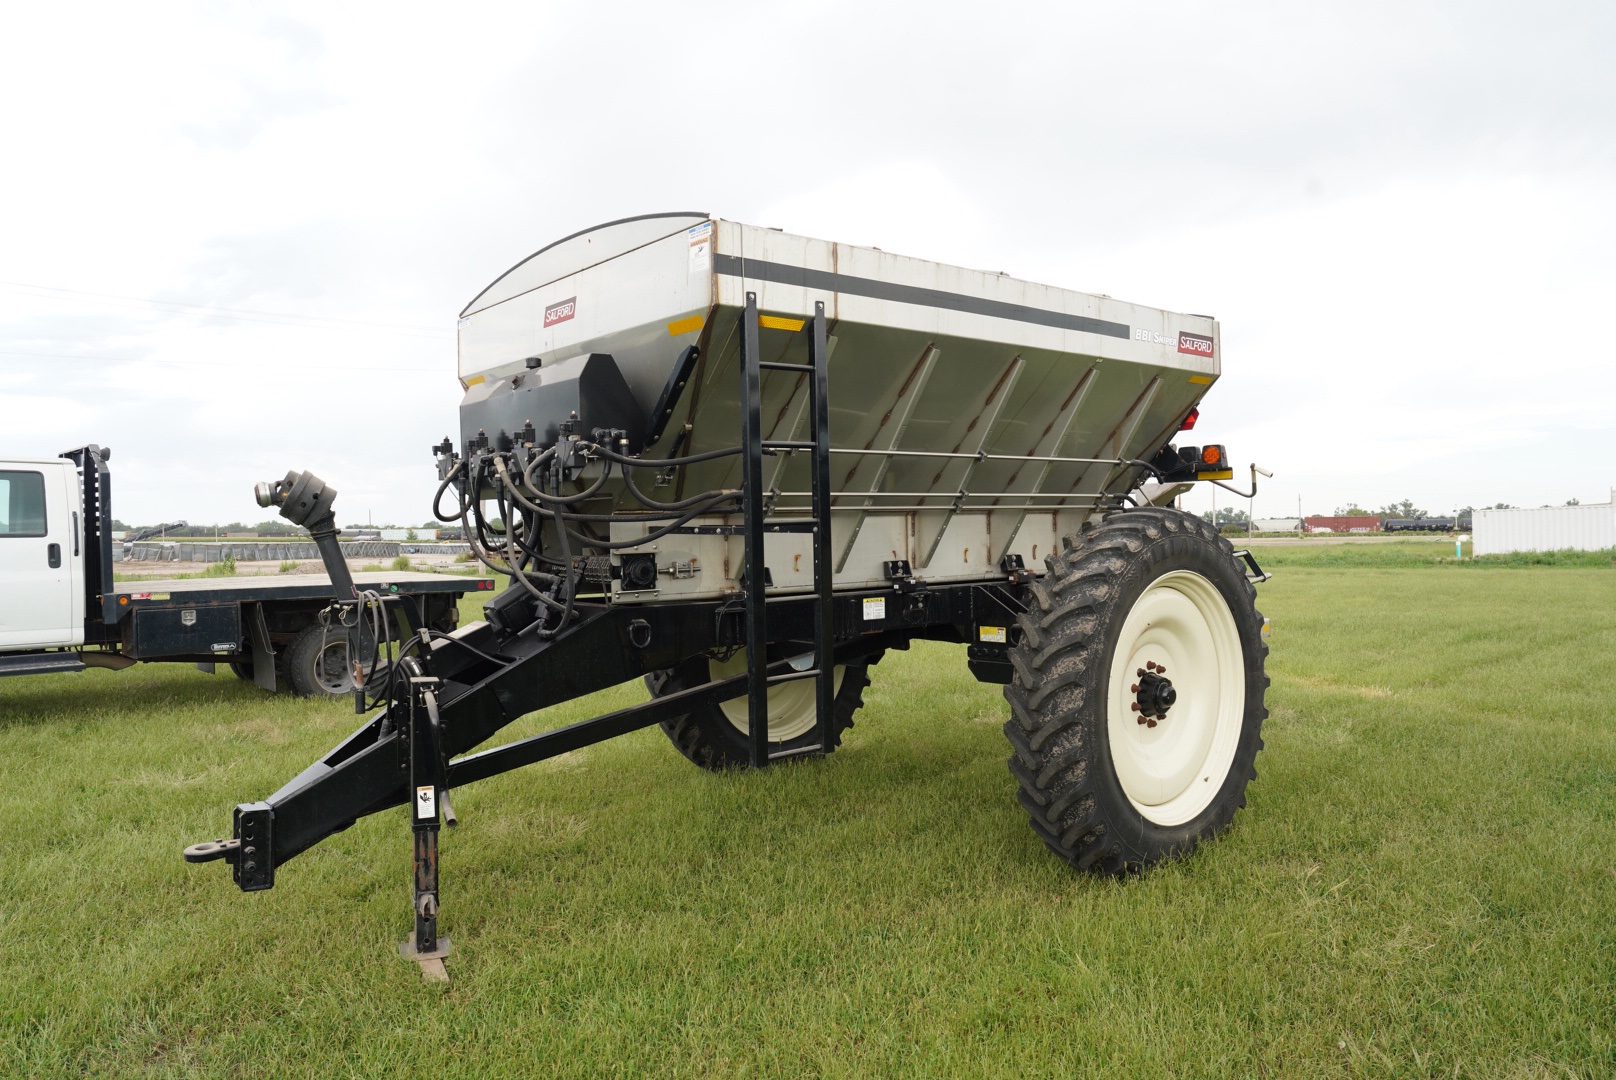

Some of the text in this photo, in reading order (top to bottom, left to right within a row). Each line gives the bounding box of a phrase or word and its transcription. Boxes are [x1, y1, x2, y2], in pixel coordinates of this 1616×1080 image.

[546, 302, 574, 323] SALFORD
[1135, 328, 1151, 342] BBI
[1180, 336, 1213, 353] SALFORD
